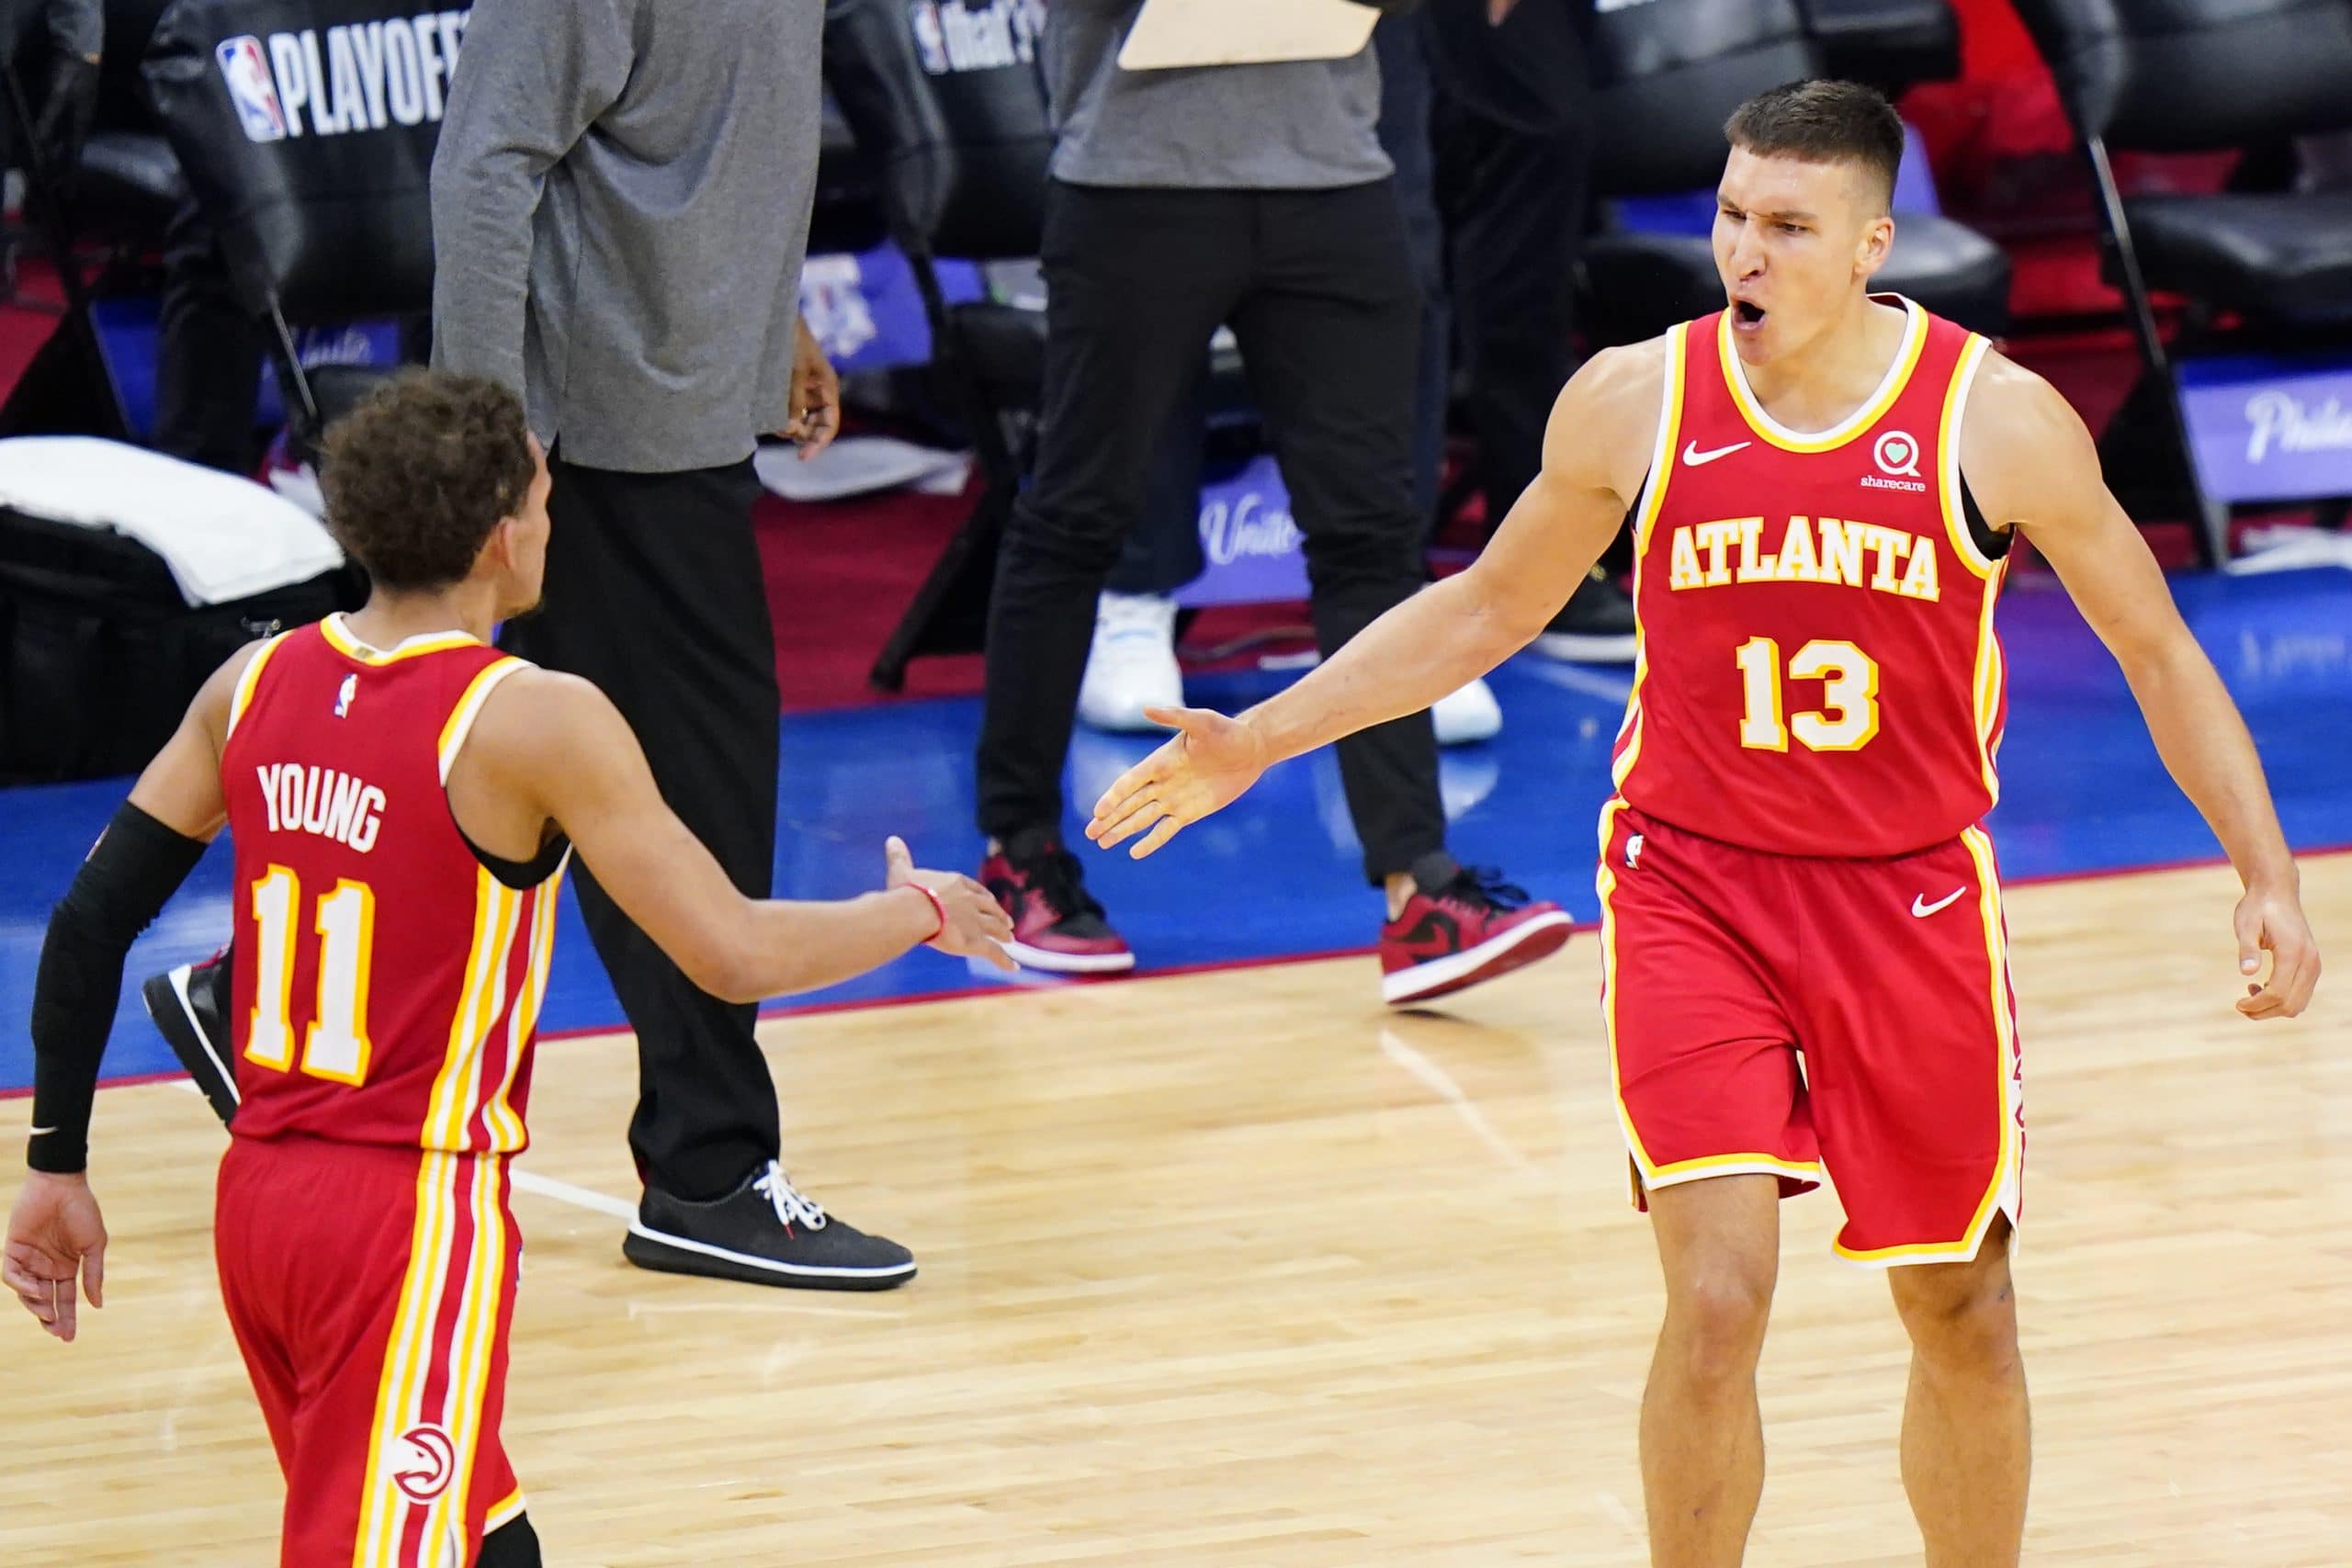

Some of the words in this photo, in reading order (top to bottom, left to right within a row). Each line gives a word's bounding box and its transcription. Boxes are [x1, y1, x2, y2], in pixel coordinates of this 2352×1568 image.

[268, 9, 471, 137] PLAYOFF
[1860, 475, 1926, 491] sharecare
[1669, 515, 1940, 603] ATLANTA
[1736, 636, 1880, 753] 13
[256, 763, 387, 853] YOUNG
[243, 863, 376, 1088] 11
